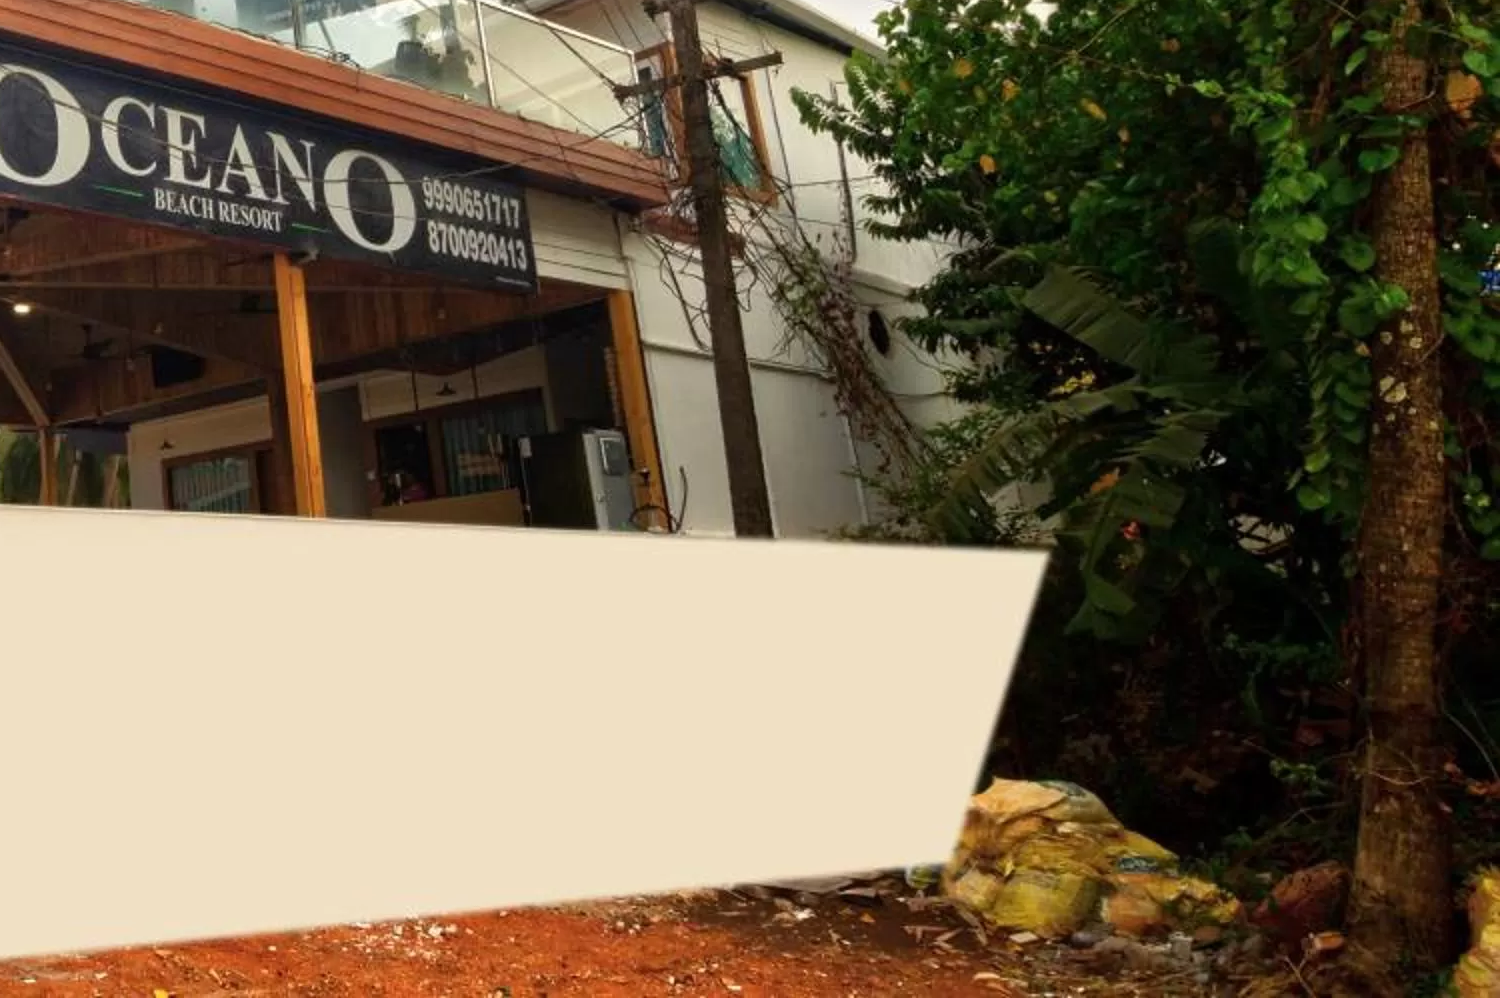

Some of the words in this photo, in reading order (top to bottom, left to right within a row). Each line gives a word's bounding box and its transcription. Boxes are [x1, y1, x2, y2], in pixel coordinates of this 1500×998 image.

[154, 187, 216, 219] BEACH
[219, 200, 283, 232] RESORT
[422, 179, 519, 229] 9990651717
[427, 220, 527, 271] 8700920413
